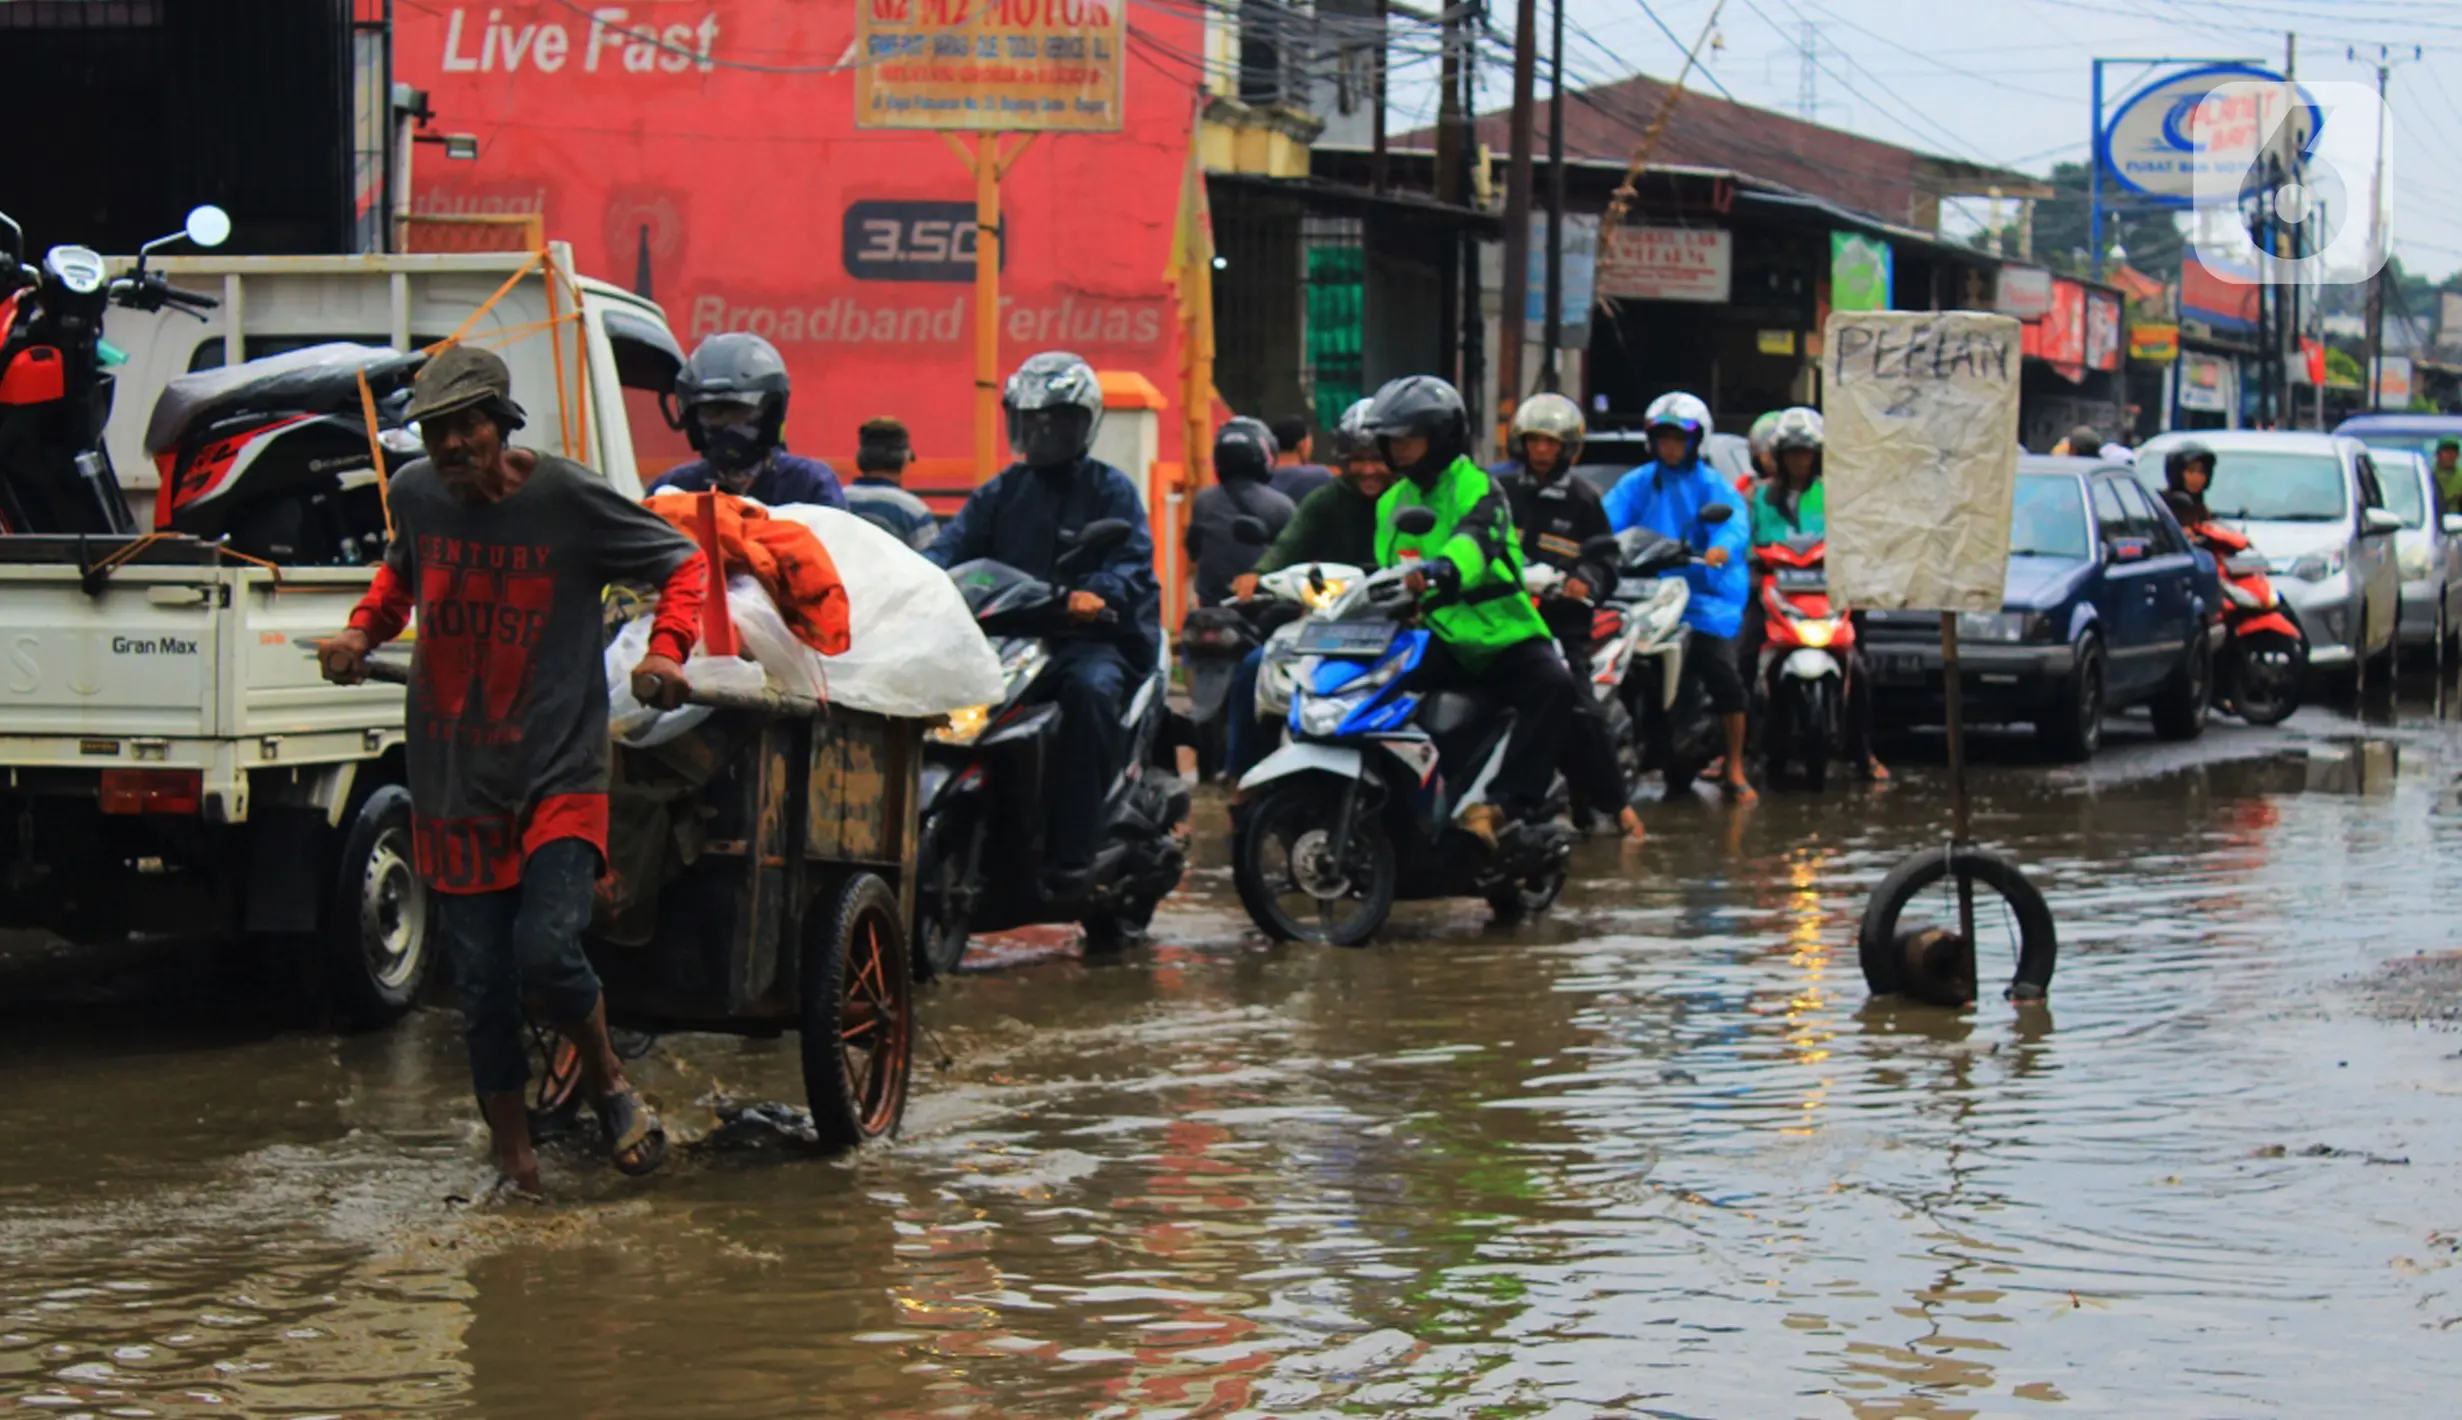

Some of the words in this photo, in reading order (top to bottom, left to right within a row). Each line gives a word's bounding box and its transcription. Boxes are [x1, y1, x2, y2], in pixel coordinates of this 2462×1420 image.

[443, 8, 569, 73] Live
[584, 9, 719, 73] Fast
[690, 295, 965, 342] Broadband
[417, 534, 552, 570] CENTURY
[112, 636, 156, 654] Gran
[160, 637, 197, 654] Max
[419, 600, 548, 649] HOUSE
